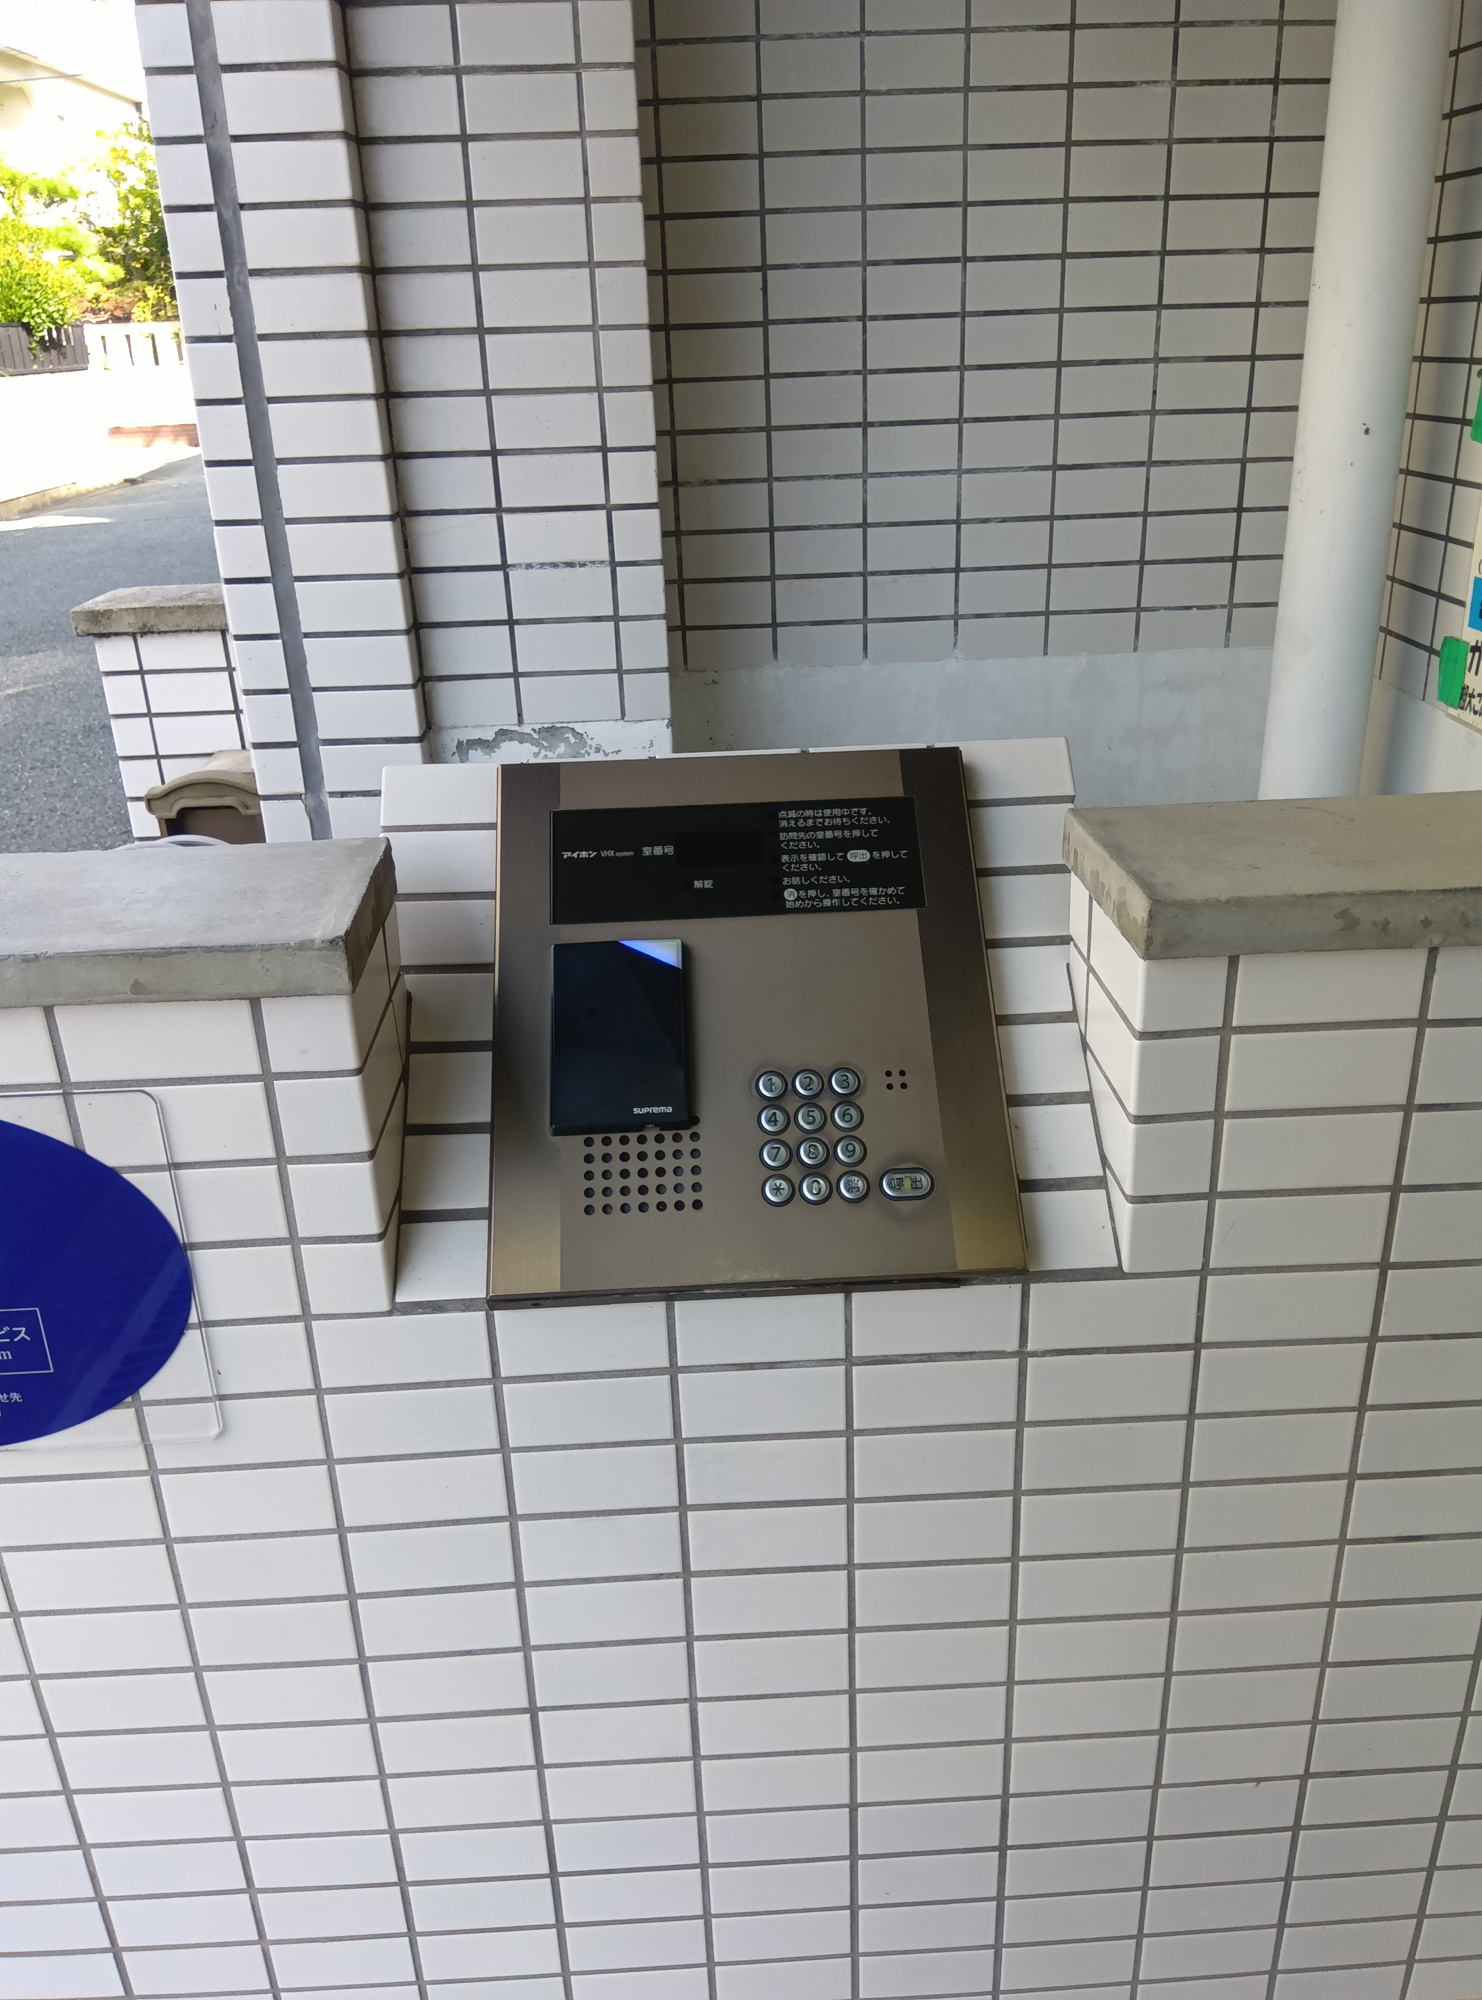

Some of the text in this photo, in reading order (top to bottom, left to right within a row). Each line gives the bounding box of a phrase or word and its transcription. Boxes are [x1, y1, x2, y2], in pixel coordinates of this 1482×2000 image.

[778, 807, 872, 819] 点滅の時は使用中です。
[779, 816, 891, 828] 消えるまでお待ちください。
[779, 829, 879, 840] 訪問先の室番号を押して
[781, 840, 821, 850] ください。
[561, 851, 598, 859] アイホン
[600, 850, 635, 858] VHX system
[641, 845, 675, 857] 室番号
[781, 852, 845, 863] 表示を確認して
[782, 863, 822, 872] ください。
[693, 879, 714, 889] 解錠
[782, 875, 850, 886] お話しください。
[785, 896, 900, 909] 始めから操作してください。
[767, 1073, 850, 1093] 1 2 3
[632, 1105, 673, 1115] suprema
[767, 1108, 853, 1126] 4 5 6
[770, 1142, 856, 1162] 7 8 9
[811, 1179, 822, 1195] 0
